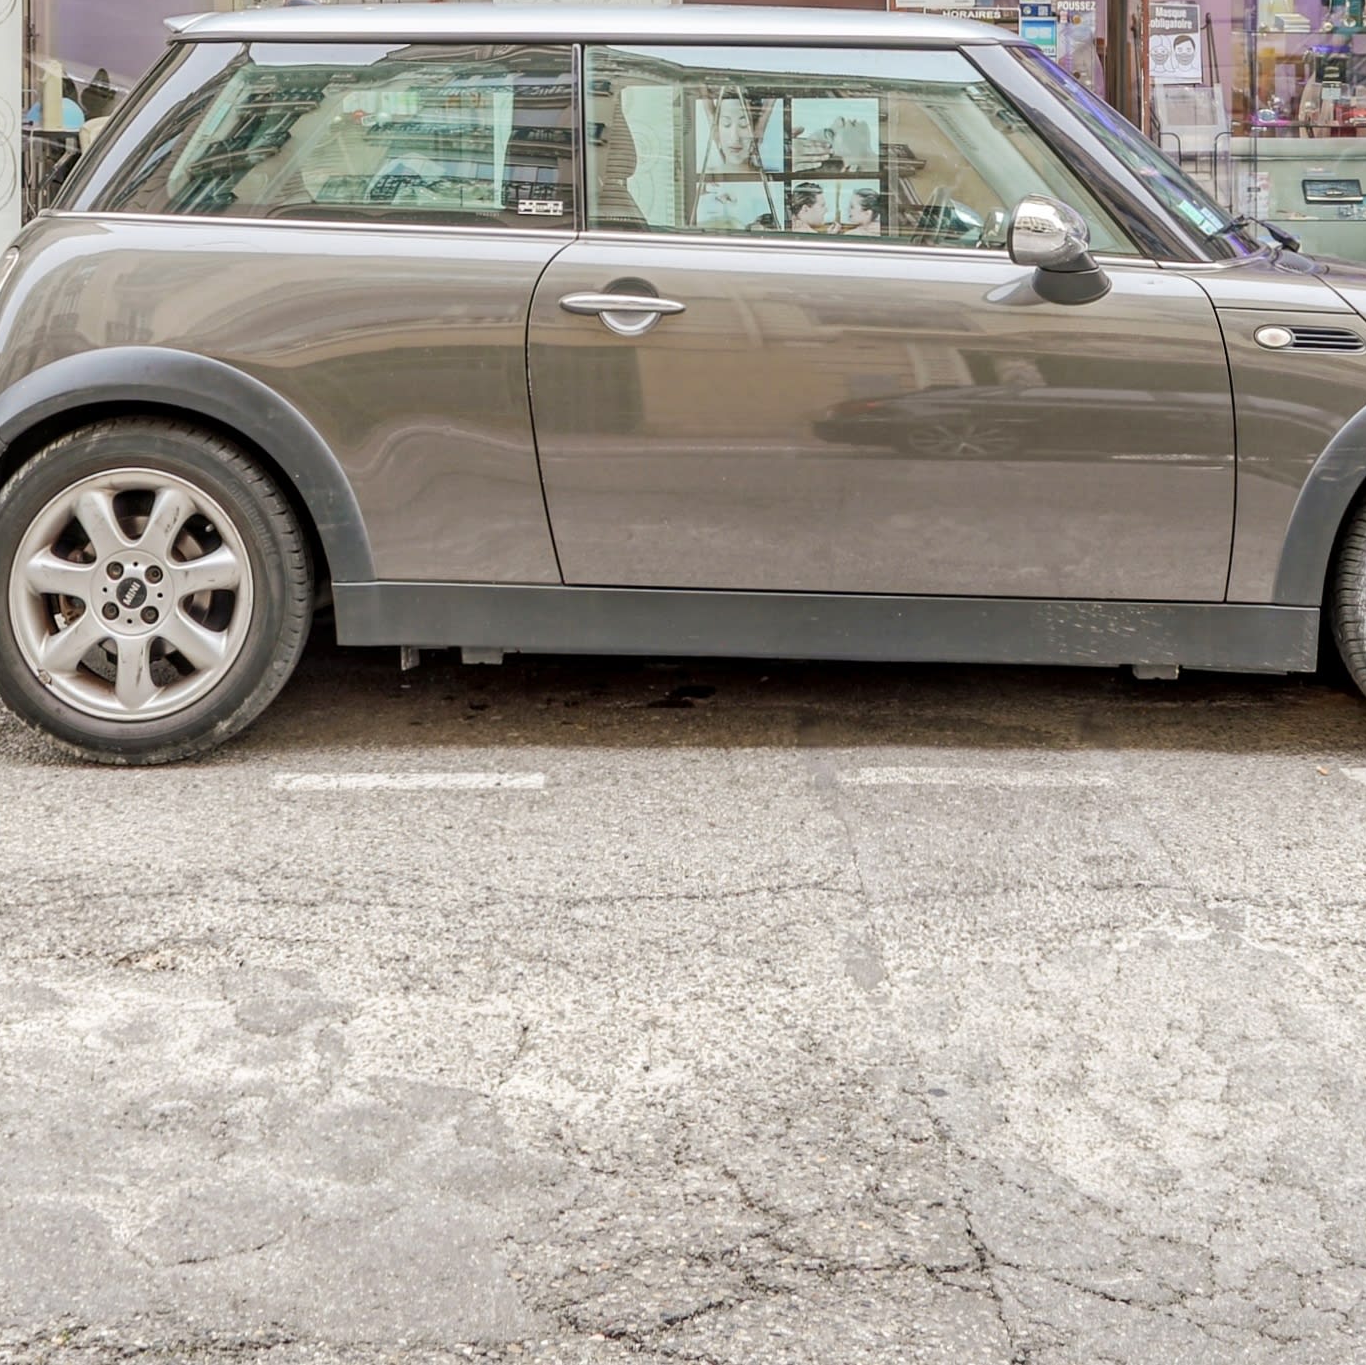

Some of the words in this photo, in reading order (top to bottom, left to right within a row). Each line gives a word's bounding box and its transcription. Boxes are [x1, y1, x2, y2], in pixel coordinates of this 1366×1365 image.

[1057, 0, 1096, 11] POUSSEZ
[942, 9, 1002, 19] HORAIRES
[1155, 7, 1187, 19] Masque
[1150, 18, 1193, 30] obligatoire
[122, 581, 141, 606] MINI
